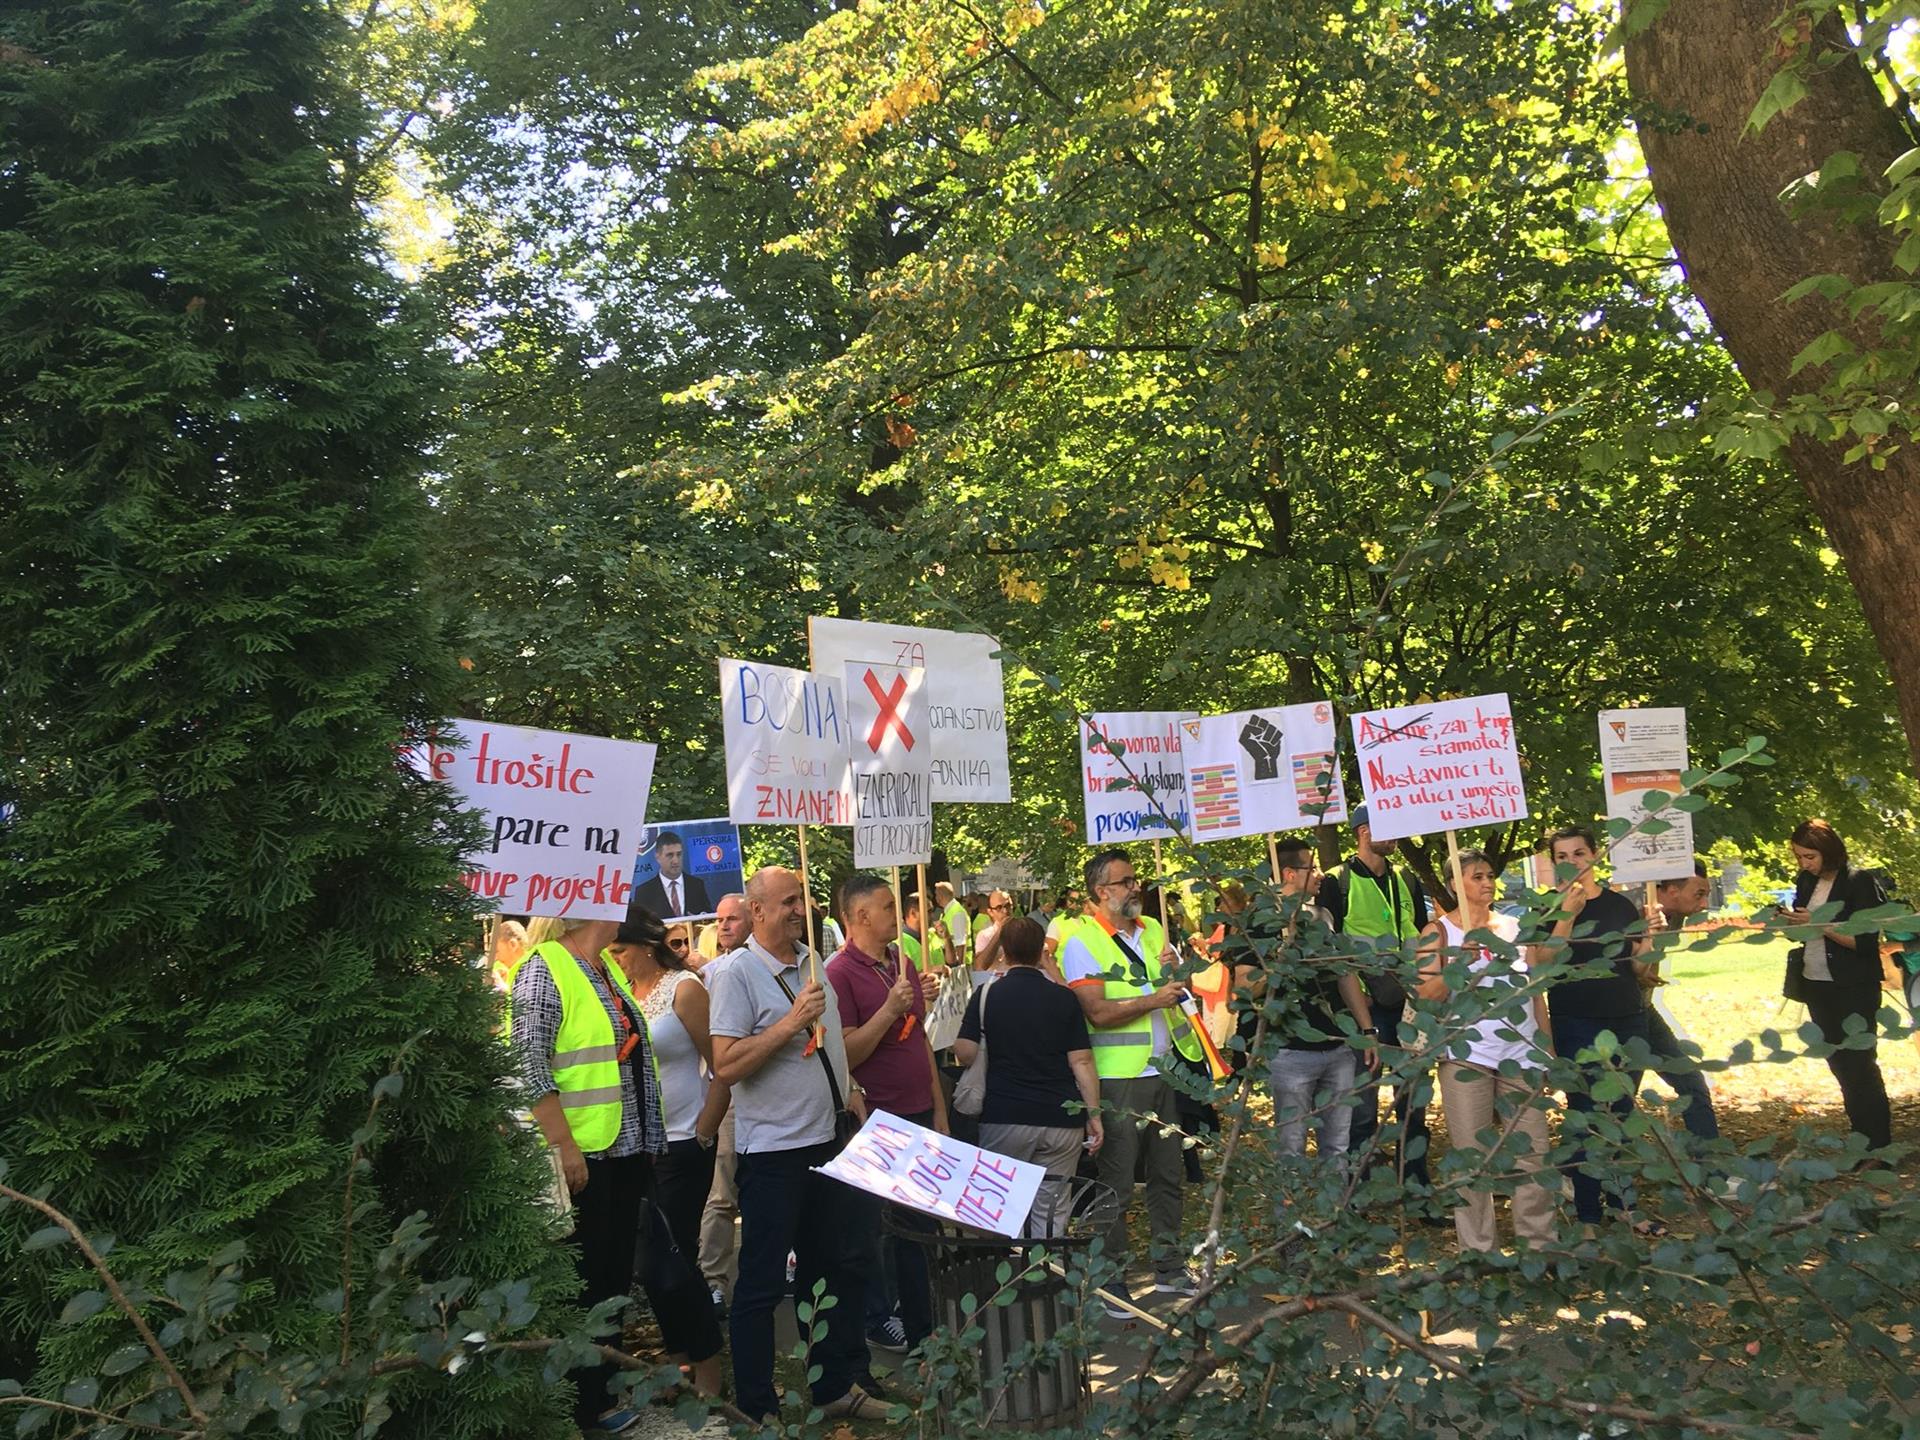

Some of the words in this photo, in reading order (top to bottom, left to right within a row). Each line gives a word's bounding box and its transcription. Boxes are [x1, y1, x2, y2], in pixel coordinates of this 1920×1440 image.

[740, 666, 840, 744] BOSNA
[929, 703, 1002, 731] OJANSTVO
[750, 751, 783, 776] SE
[792, 755, 827, 777] VOLI
[931, 759, 990, 787] ADNIKA
[1367, 755, 1479, 794] Nastavnici
[1377, 796, 1402, 811] na
[1410, 787, 1455, 805] ulici
[1440, 809, 1454, 821] u
[492, 815, 569, 854] pare
[585, 826, 621, 855] na
[857, 824, 877, 857] STE
